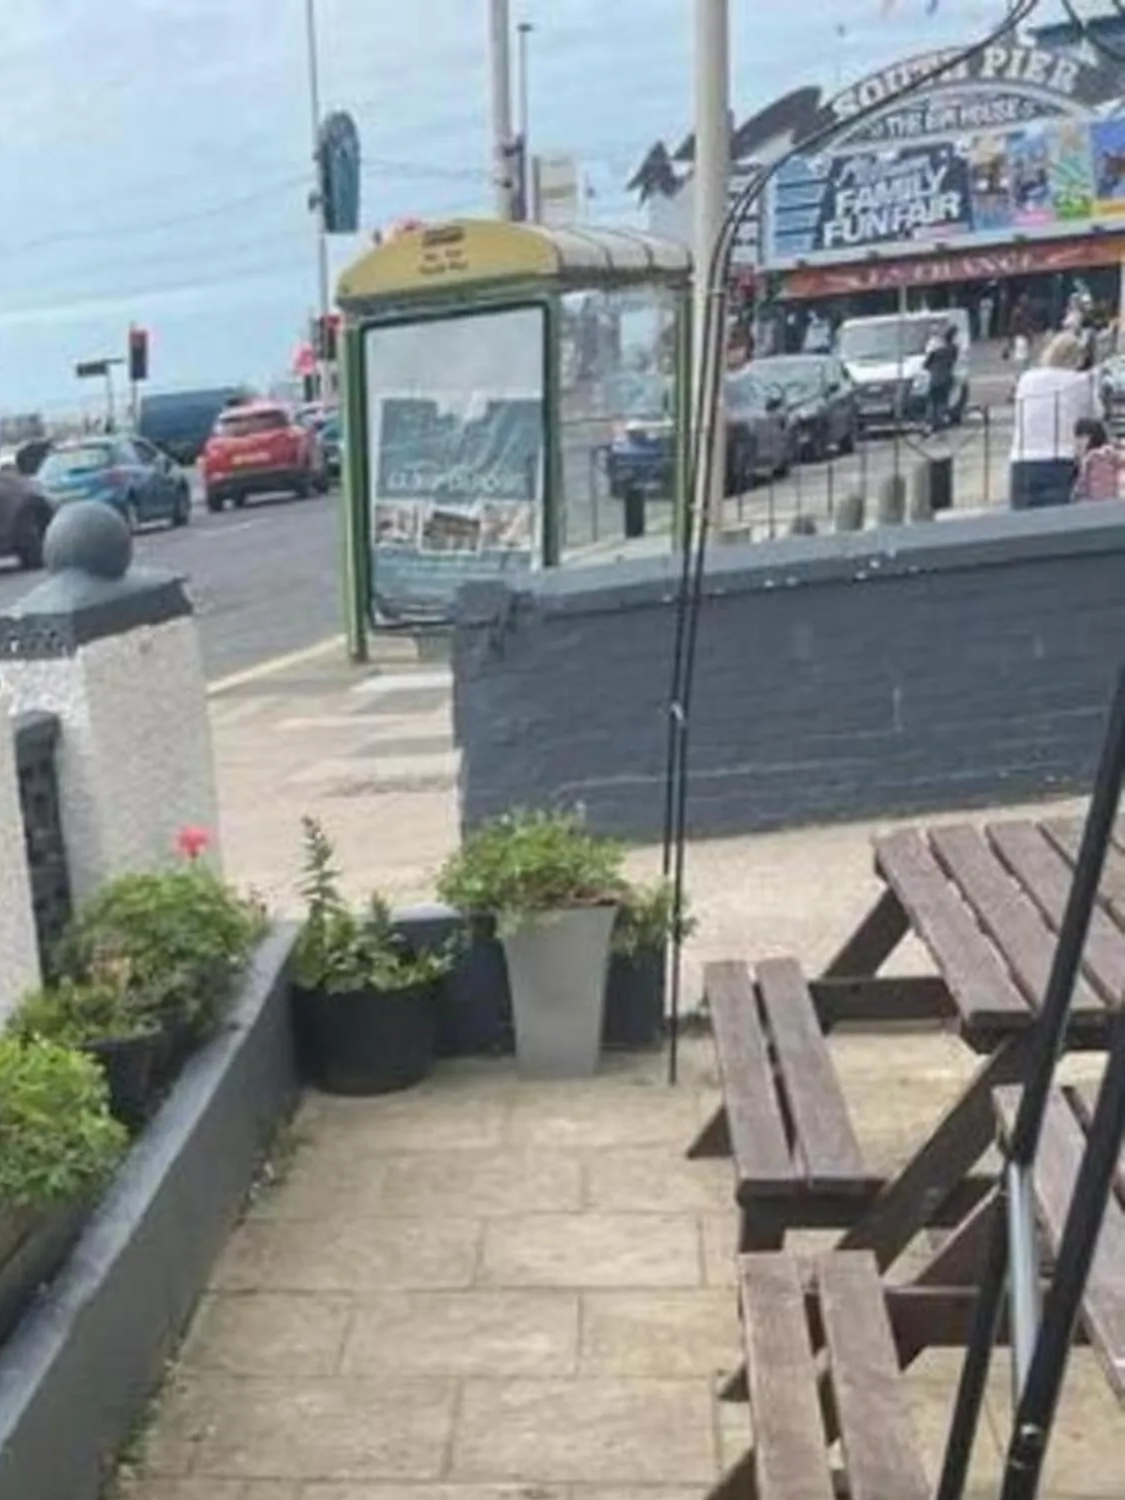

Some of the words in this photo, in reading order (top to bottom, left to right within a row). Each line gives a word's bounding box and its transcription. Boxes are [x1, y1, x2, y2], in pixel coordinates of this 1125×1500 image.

[831, 50, 969, 120] SOUTH
[979, 47, 1079, 95] PIER
[835, 165, 948, 218] FAMILY
